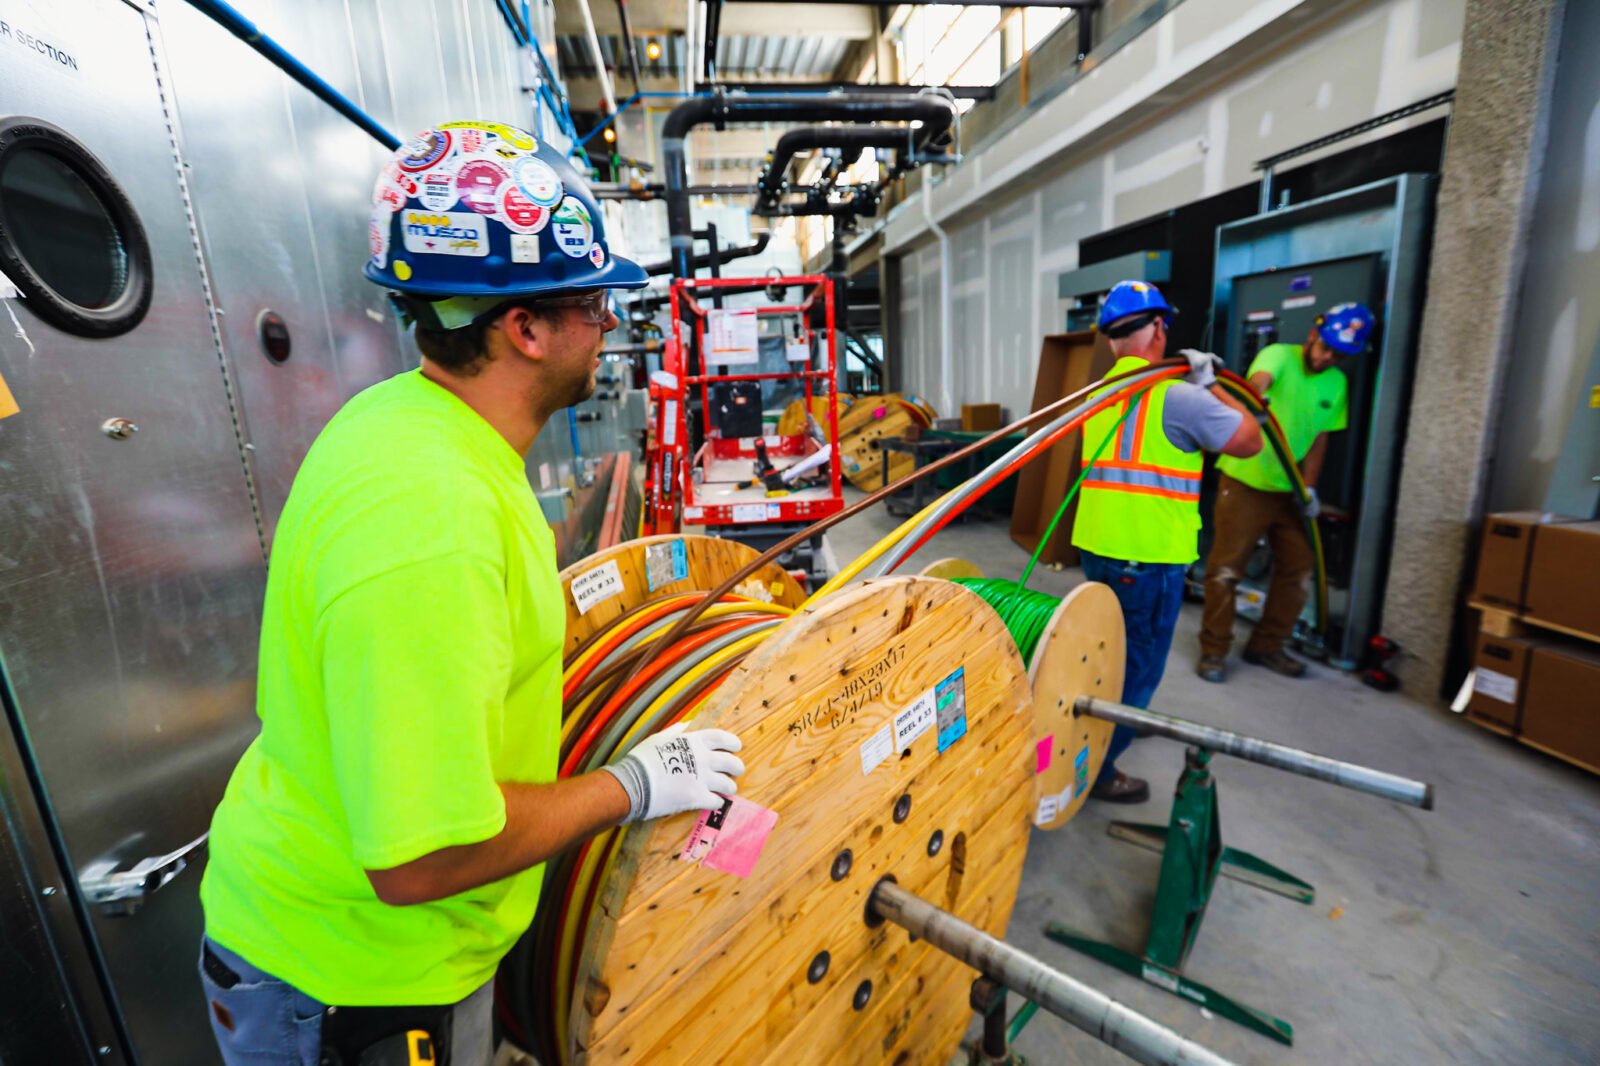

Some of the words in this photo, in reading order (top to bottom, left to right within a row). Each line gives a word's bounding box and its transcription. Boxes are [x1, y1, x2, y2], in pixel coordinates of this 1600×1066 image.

[16, 29, 78, 71] SECTION
[578, 587, 596, 601] REEL
[899, 721, 916, 738] REEL
